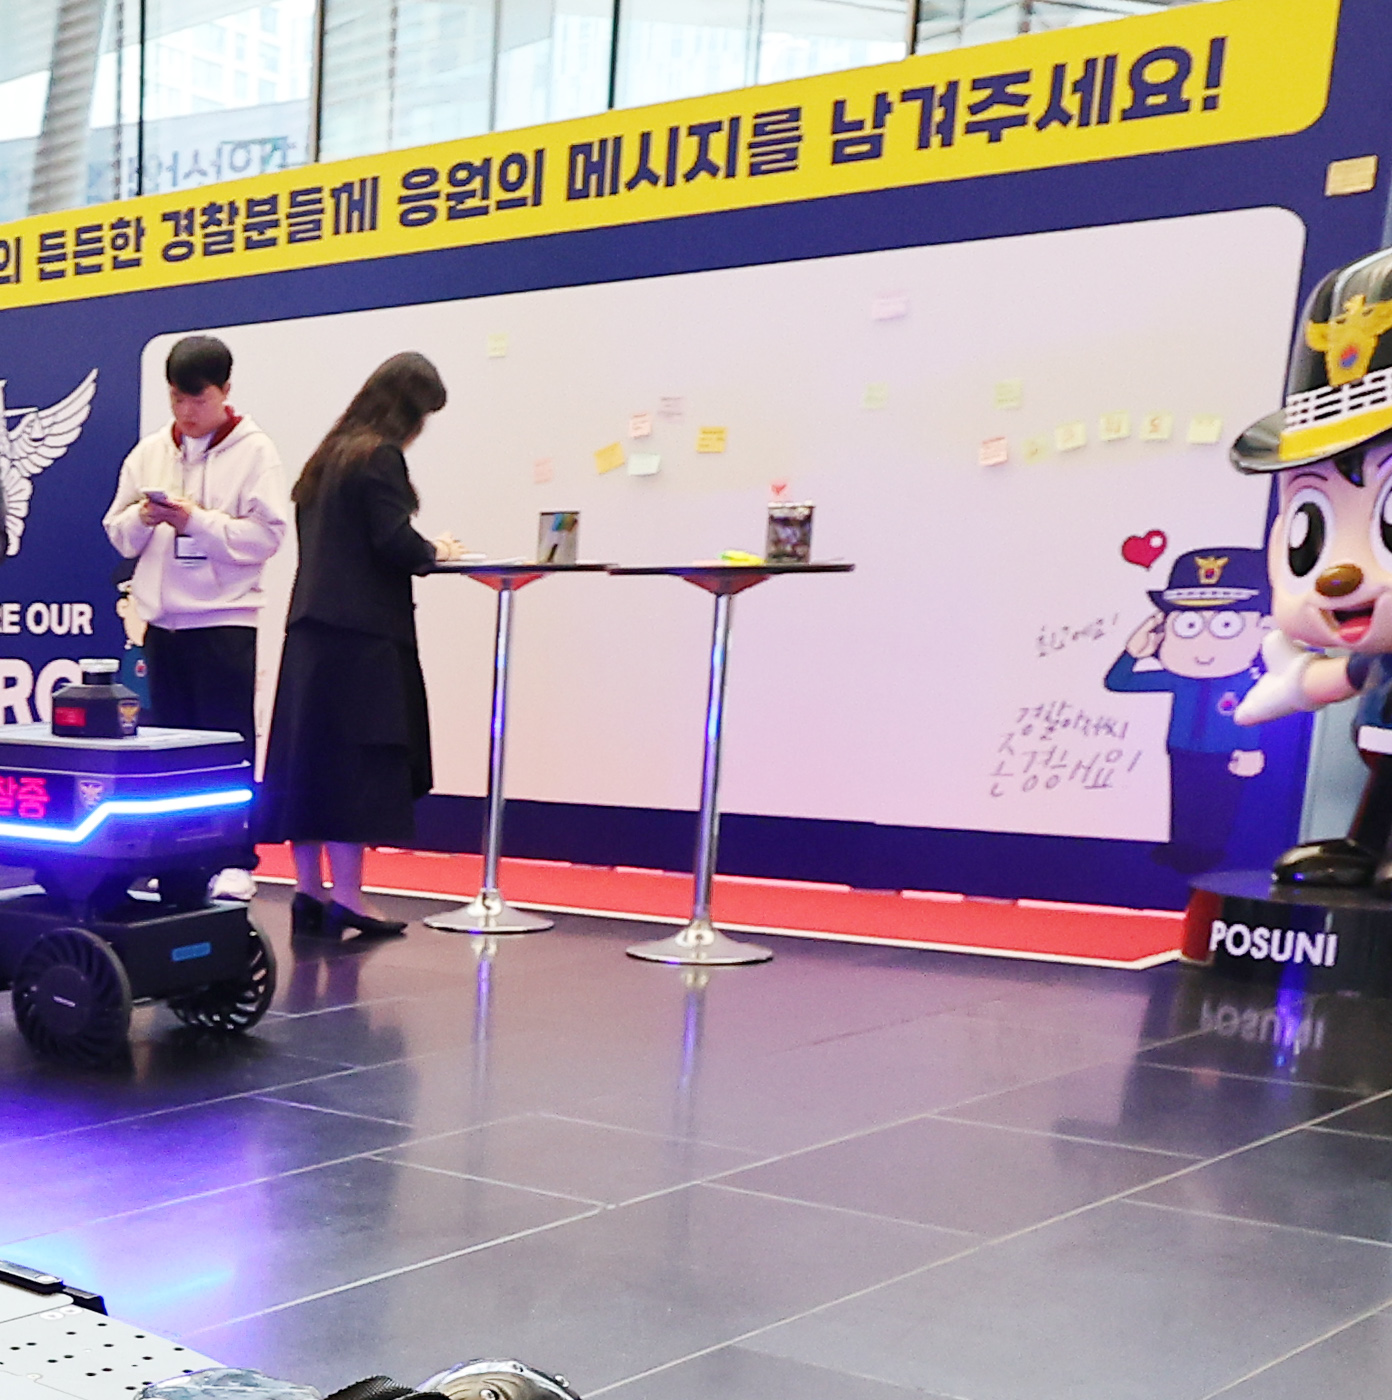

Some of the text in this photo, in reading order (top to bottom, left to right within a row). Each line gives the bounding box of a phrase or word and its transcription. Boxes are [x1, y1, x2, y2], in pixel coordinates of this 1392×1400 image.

[36, 216, 146, 282] 든든한
[161, 175, 381, 263] 경찰분들께
[397, 148, 548, 228] 응원의
[565, 106, 804, 202] 메시지를
[830, 36, 1228, 166] 남겨주세요!
[25, 602, 93, 635] OUR
[1209, 919, 1338, 967] POSUNI
